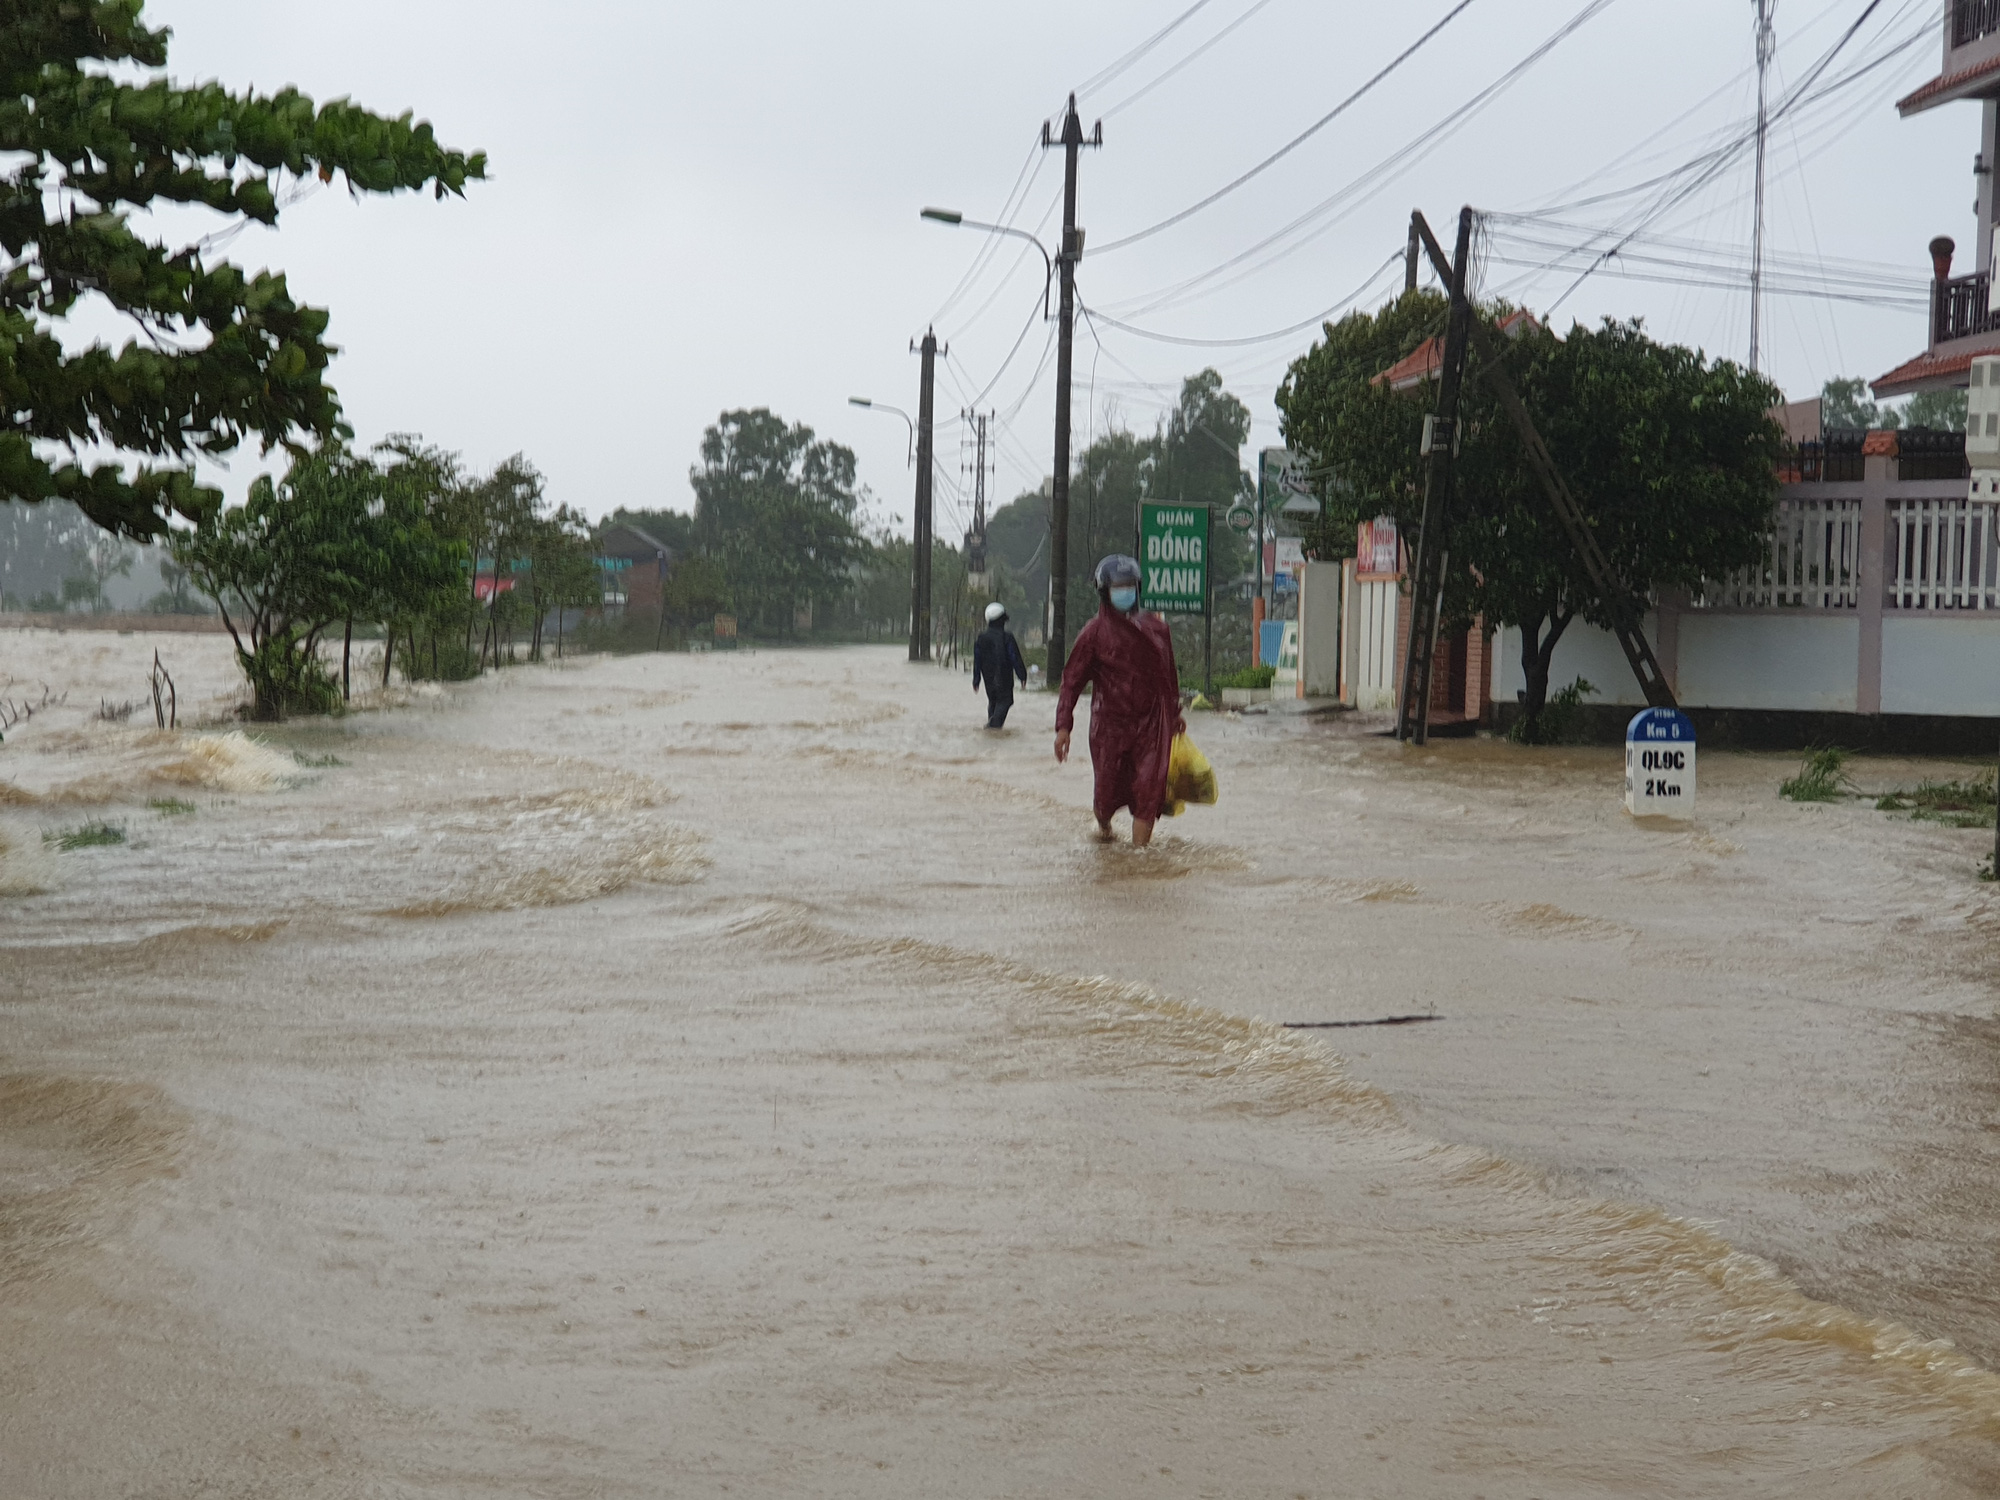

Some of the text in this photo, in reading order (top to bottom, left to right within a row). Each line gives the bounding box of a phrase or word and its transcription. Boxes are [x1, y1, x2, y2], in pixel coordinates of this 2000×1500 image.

[1147, 567, 1201, 595] XANH
[1646, 722, 1666, 738] Km
[1642, 750, 1684, 771] QL9C
